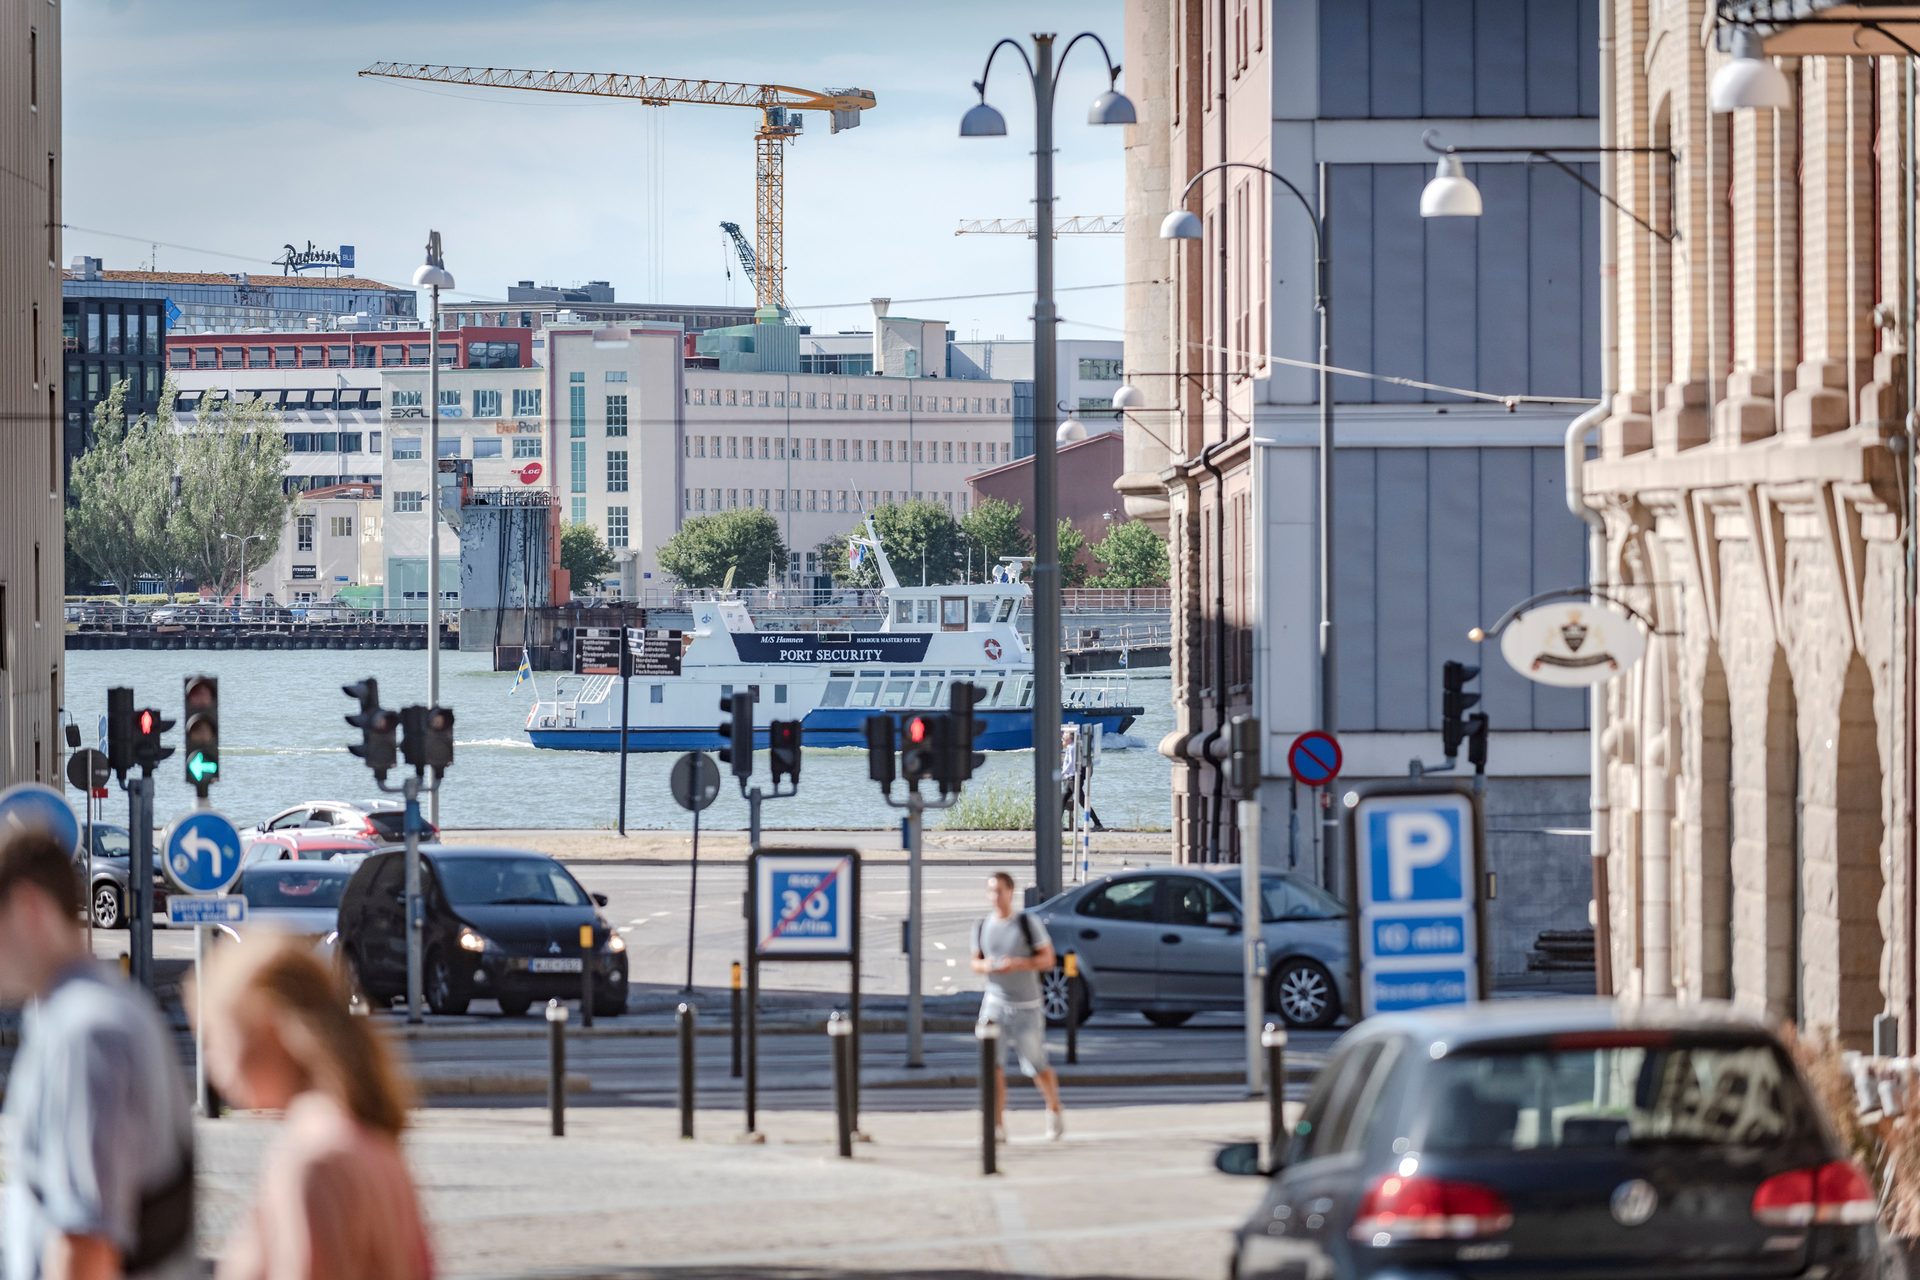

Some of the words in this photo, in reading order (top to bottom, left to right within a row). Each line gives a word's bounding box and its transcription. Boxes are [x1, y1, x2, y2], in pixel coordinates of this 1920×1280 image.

[272, 239, 340, 277] Radisson
[343, 253, 354, 261] BLU
[760, 636, 775, 644] M/S
[776, 636, 804, 644] Hamnen
[779, 649, 813, 661] PORT
[816, 649, 883, 661] SECURITY
[1388, 810, 1453, 900] P
[781, 890, 829, 920] 30
[1377, 922, 1411, 952] 10
